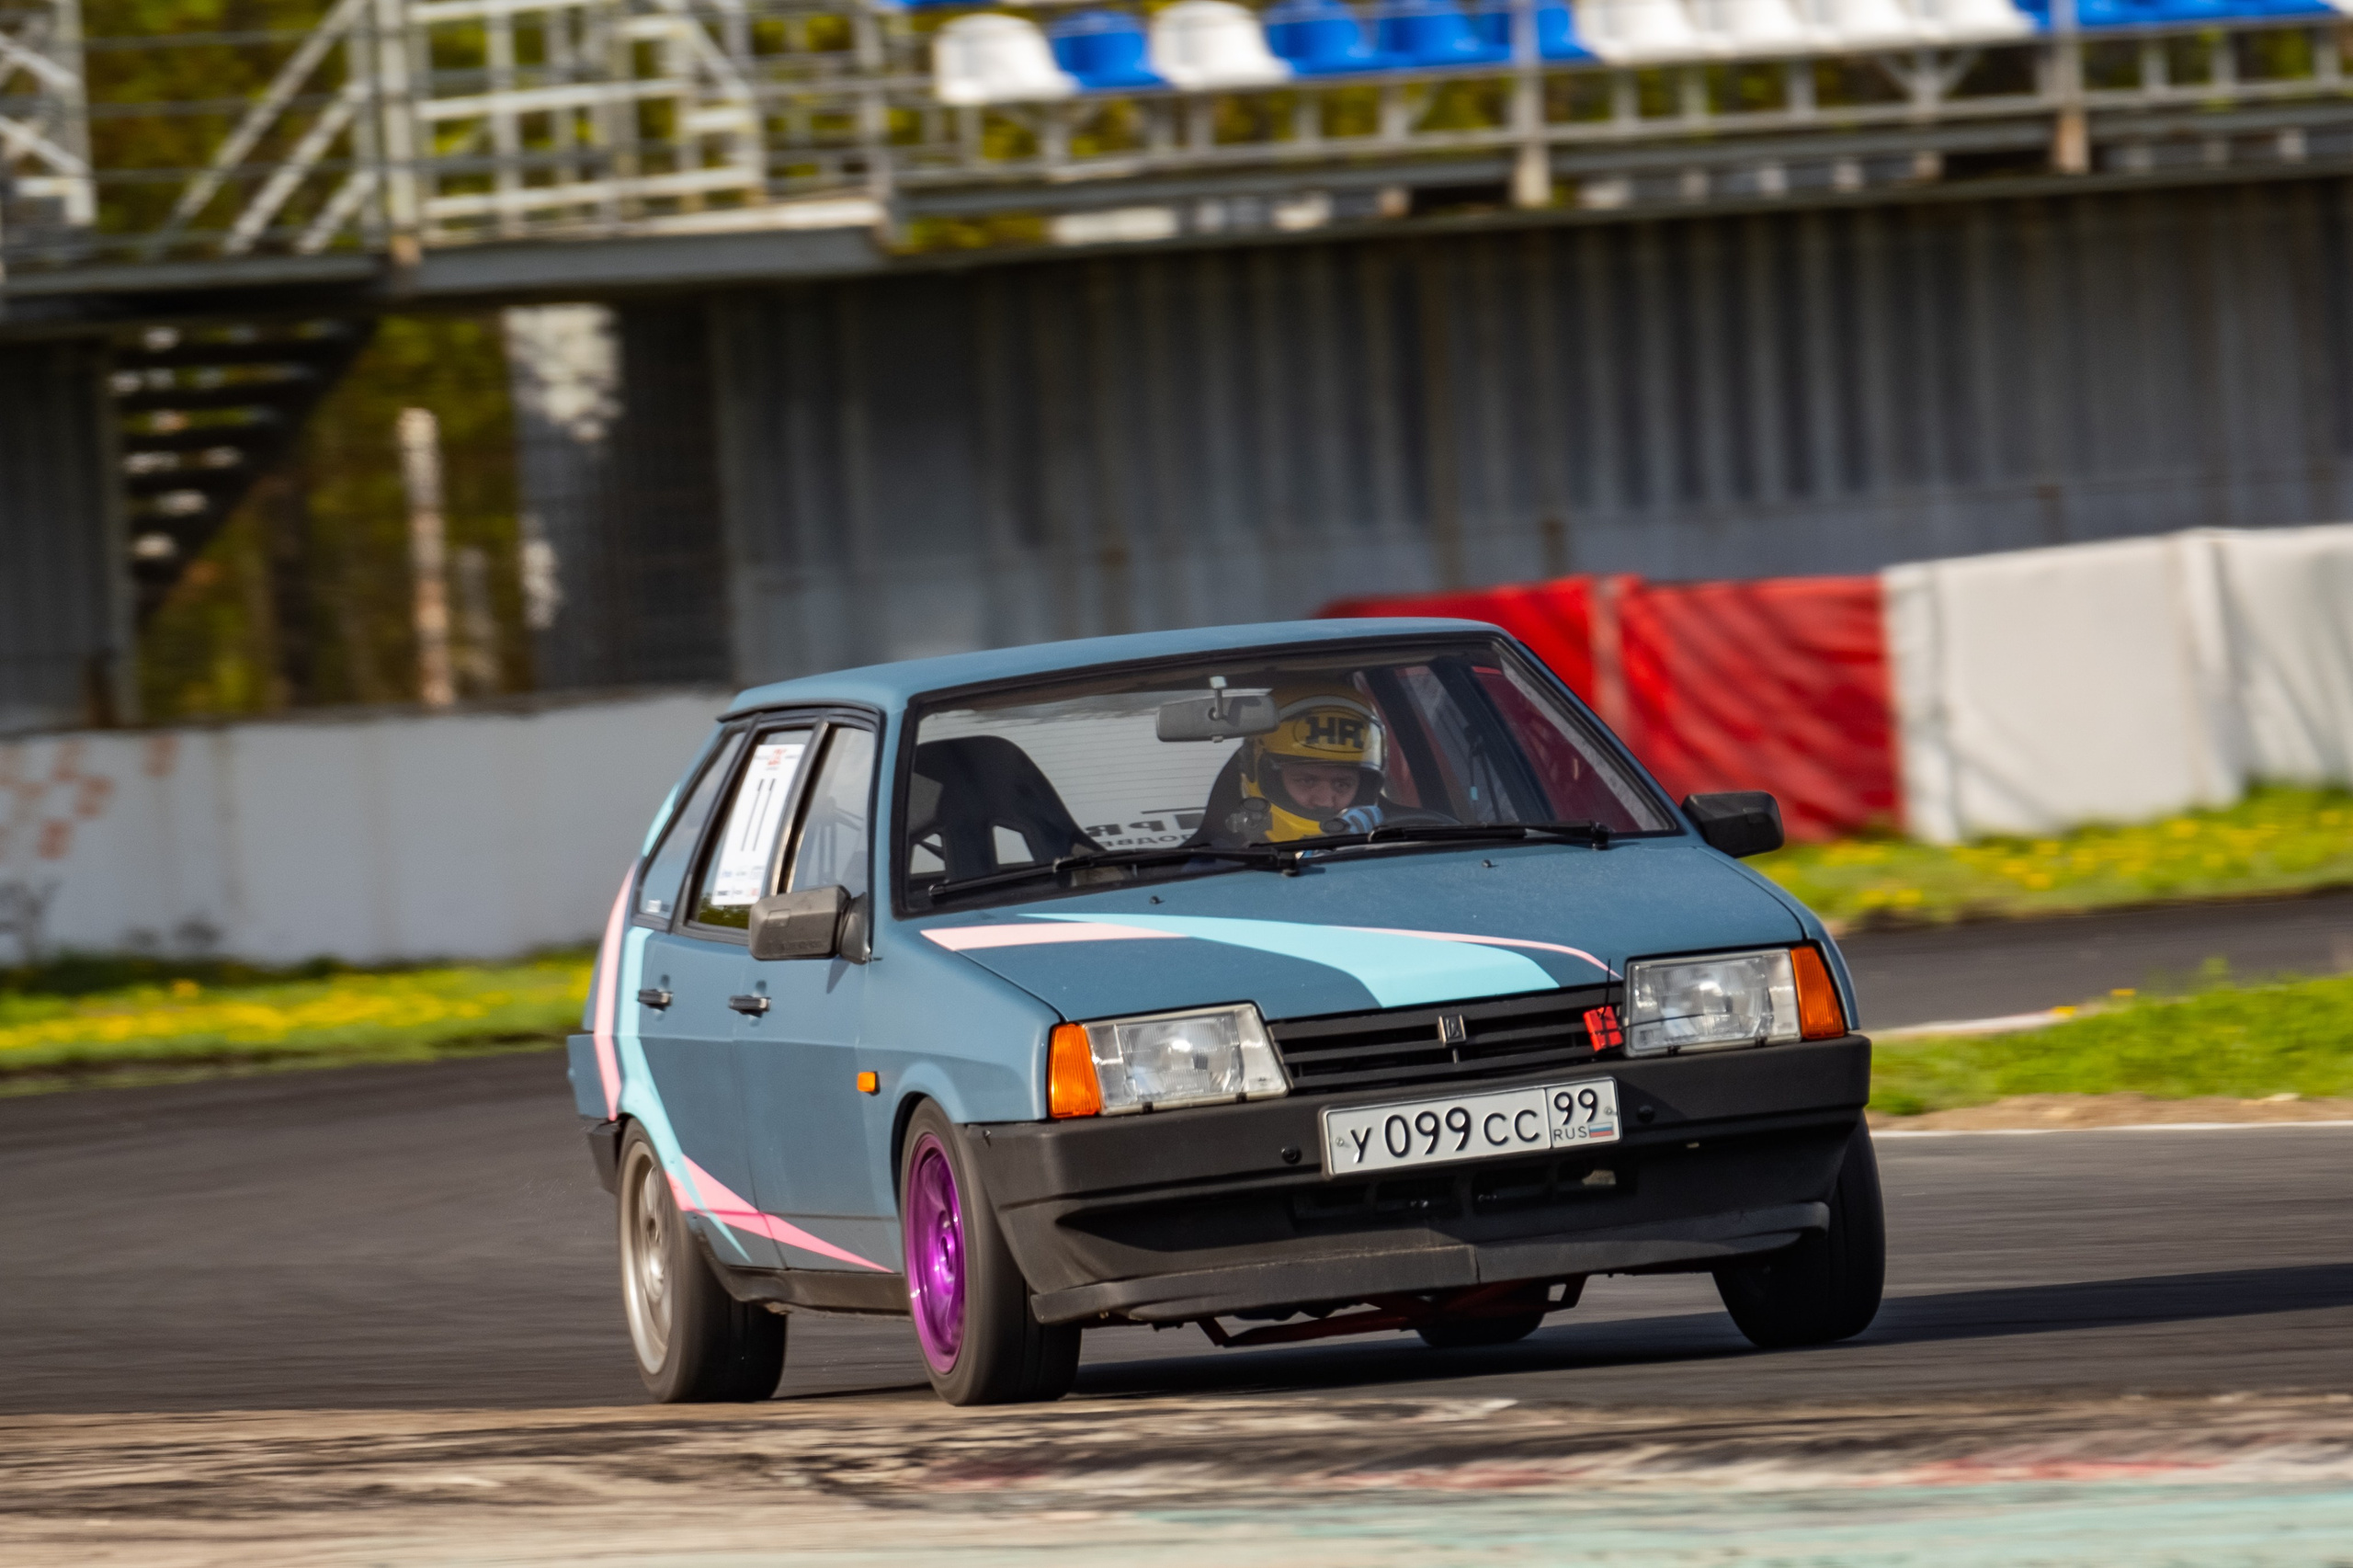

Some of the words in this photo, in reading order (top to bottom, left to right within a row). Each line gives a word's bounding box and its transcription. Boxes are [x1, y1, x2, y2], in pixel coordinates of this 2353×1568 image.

[1553, 1088, 1599, 1126] 99
[1383, 1106, 1472, 1158] 099
[1553, 1126, 1588, 1142] RUS
